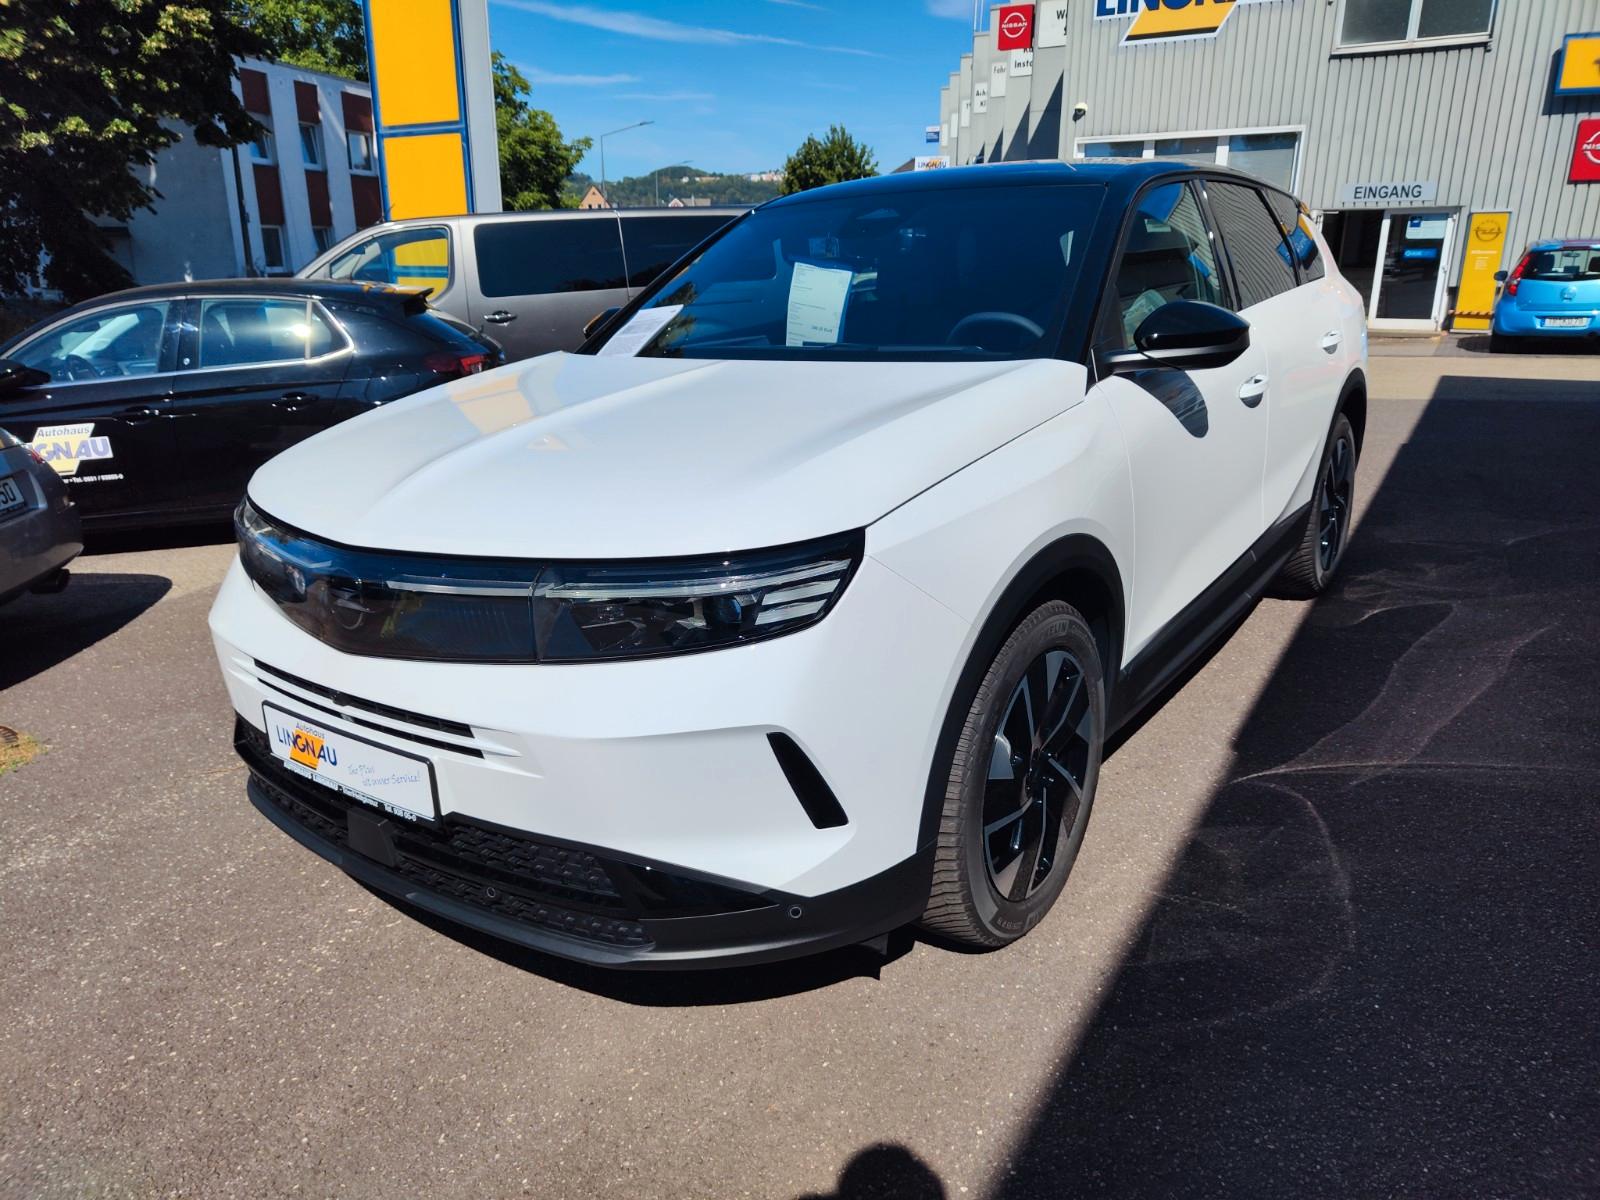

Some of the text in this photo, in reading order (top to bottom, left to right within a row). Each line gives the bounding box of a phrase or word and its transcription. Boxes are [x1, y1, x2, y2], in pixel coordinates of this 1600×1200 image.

[1354, 185, 1422, 199] EINGANG
[37, 427, 90, 437] Autohaus
[34, 439, 110, 460] GNAU
[296, 722, 325, 739] Autohaus
[276, 725, 338, 766] LINGNAU
